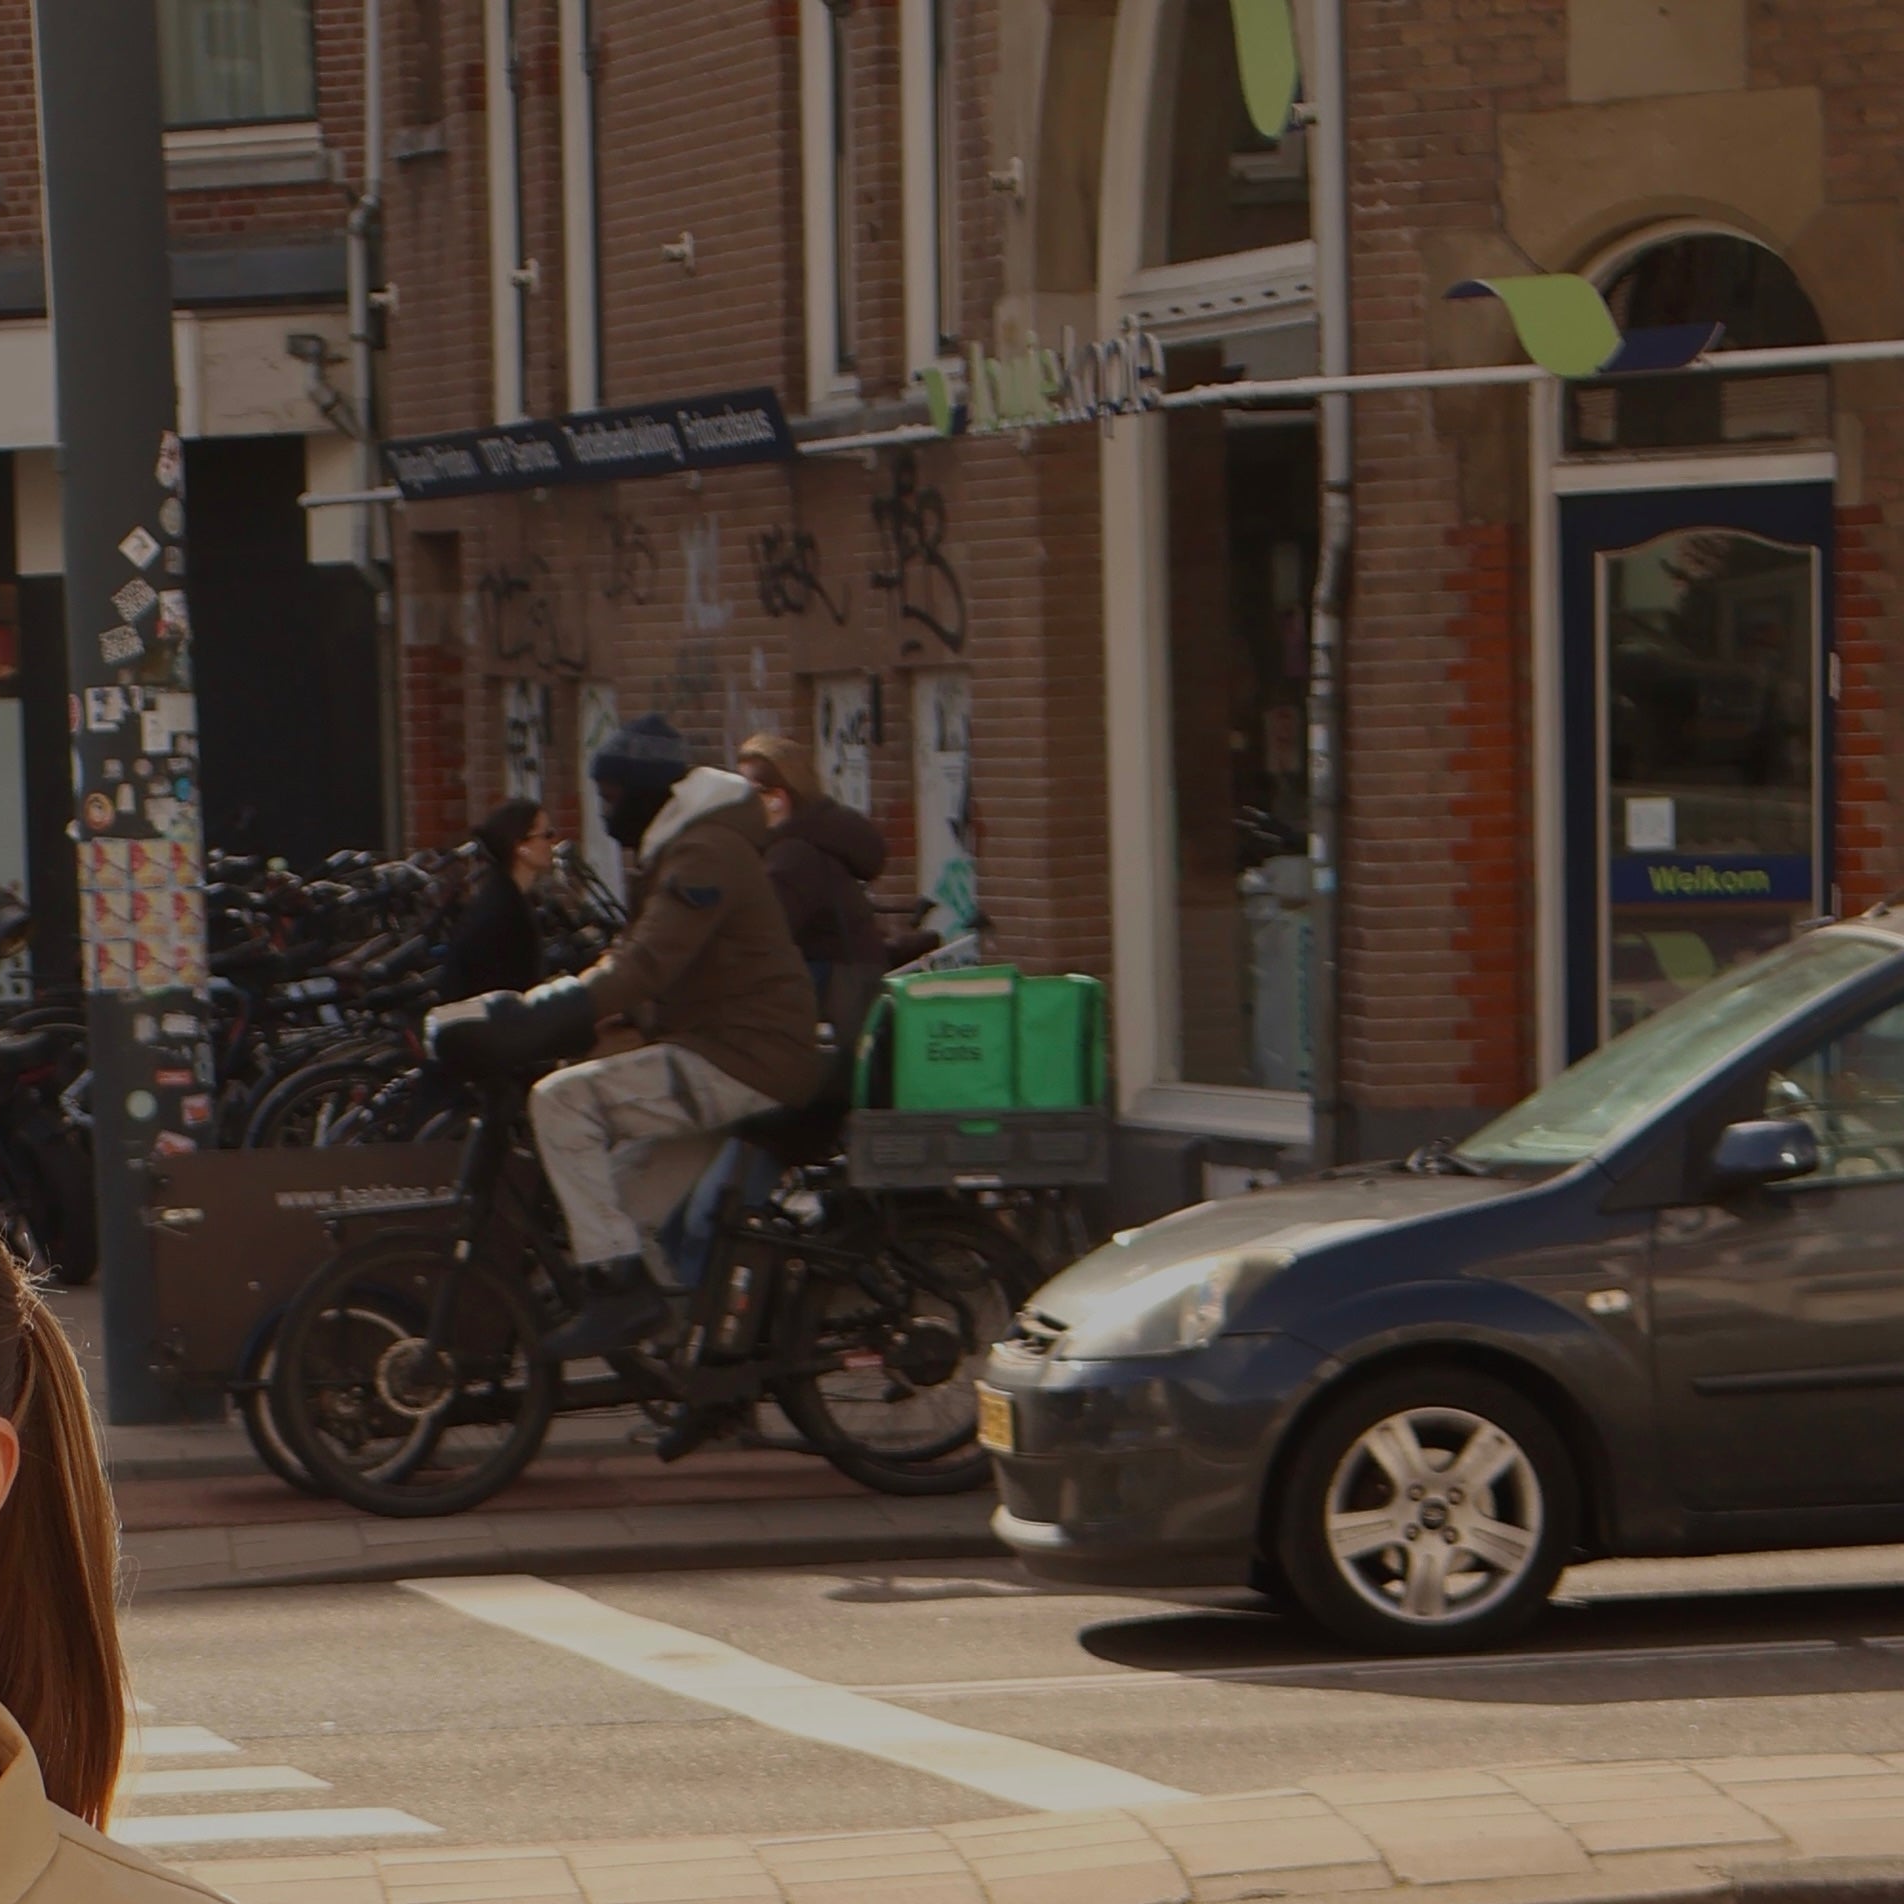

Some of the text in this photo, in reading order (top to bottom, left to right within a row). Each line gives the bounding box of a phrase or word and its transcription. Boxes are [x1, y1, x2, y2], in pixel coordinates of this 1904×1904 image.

[1647, 864, 1771, 896] Welkom
[927, 1020, 981, 1039] Uber
[927, 1041, 983, 1062] Eats
